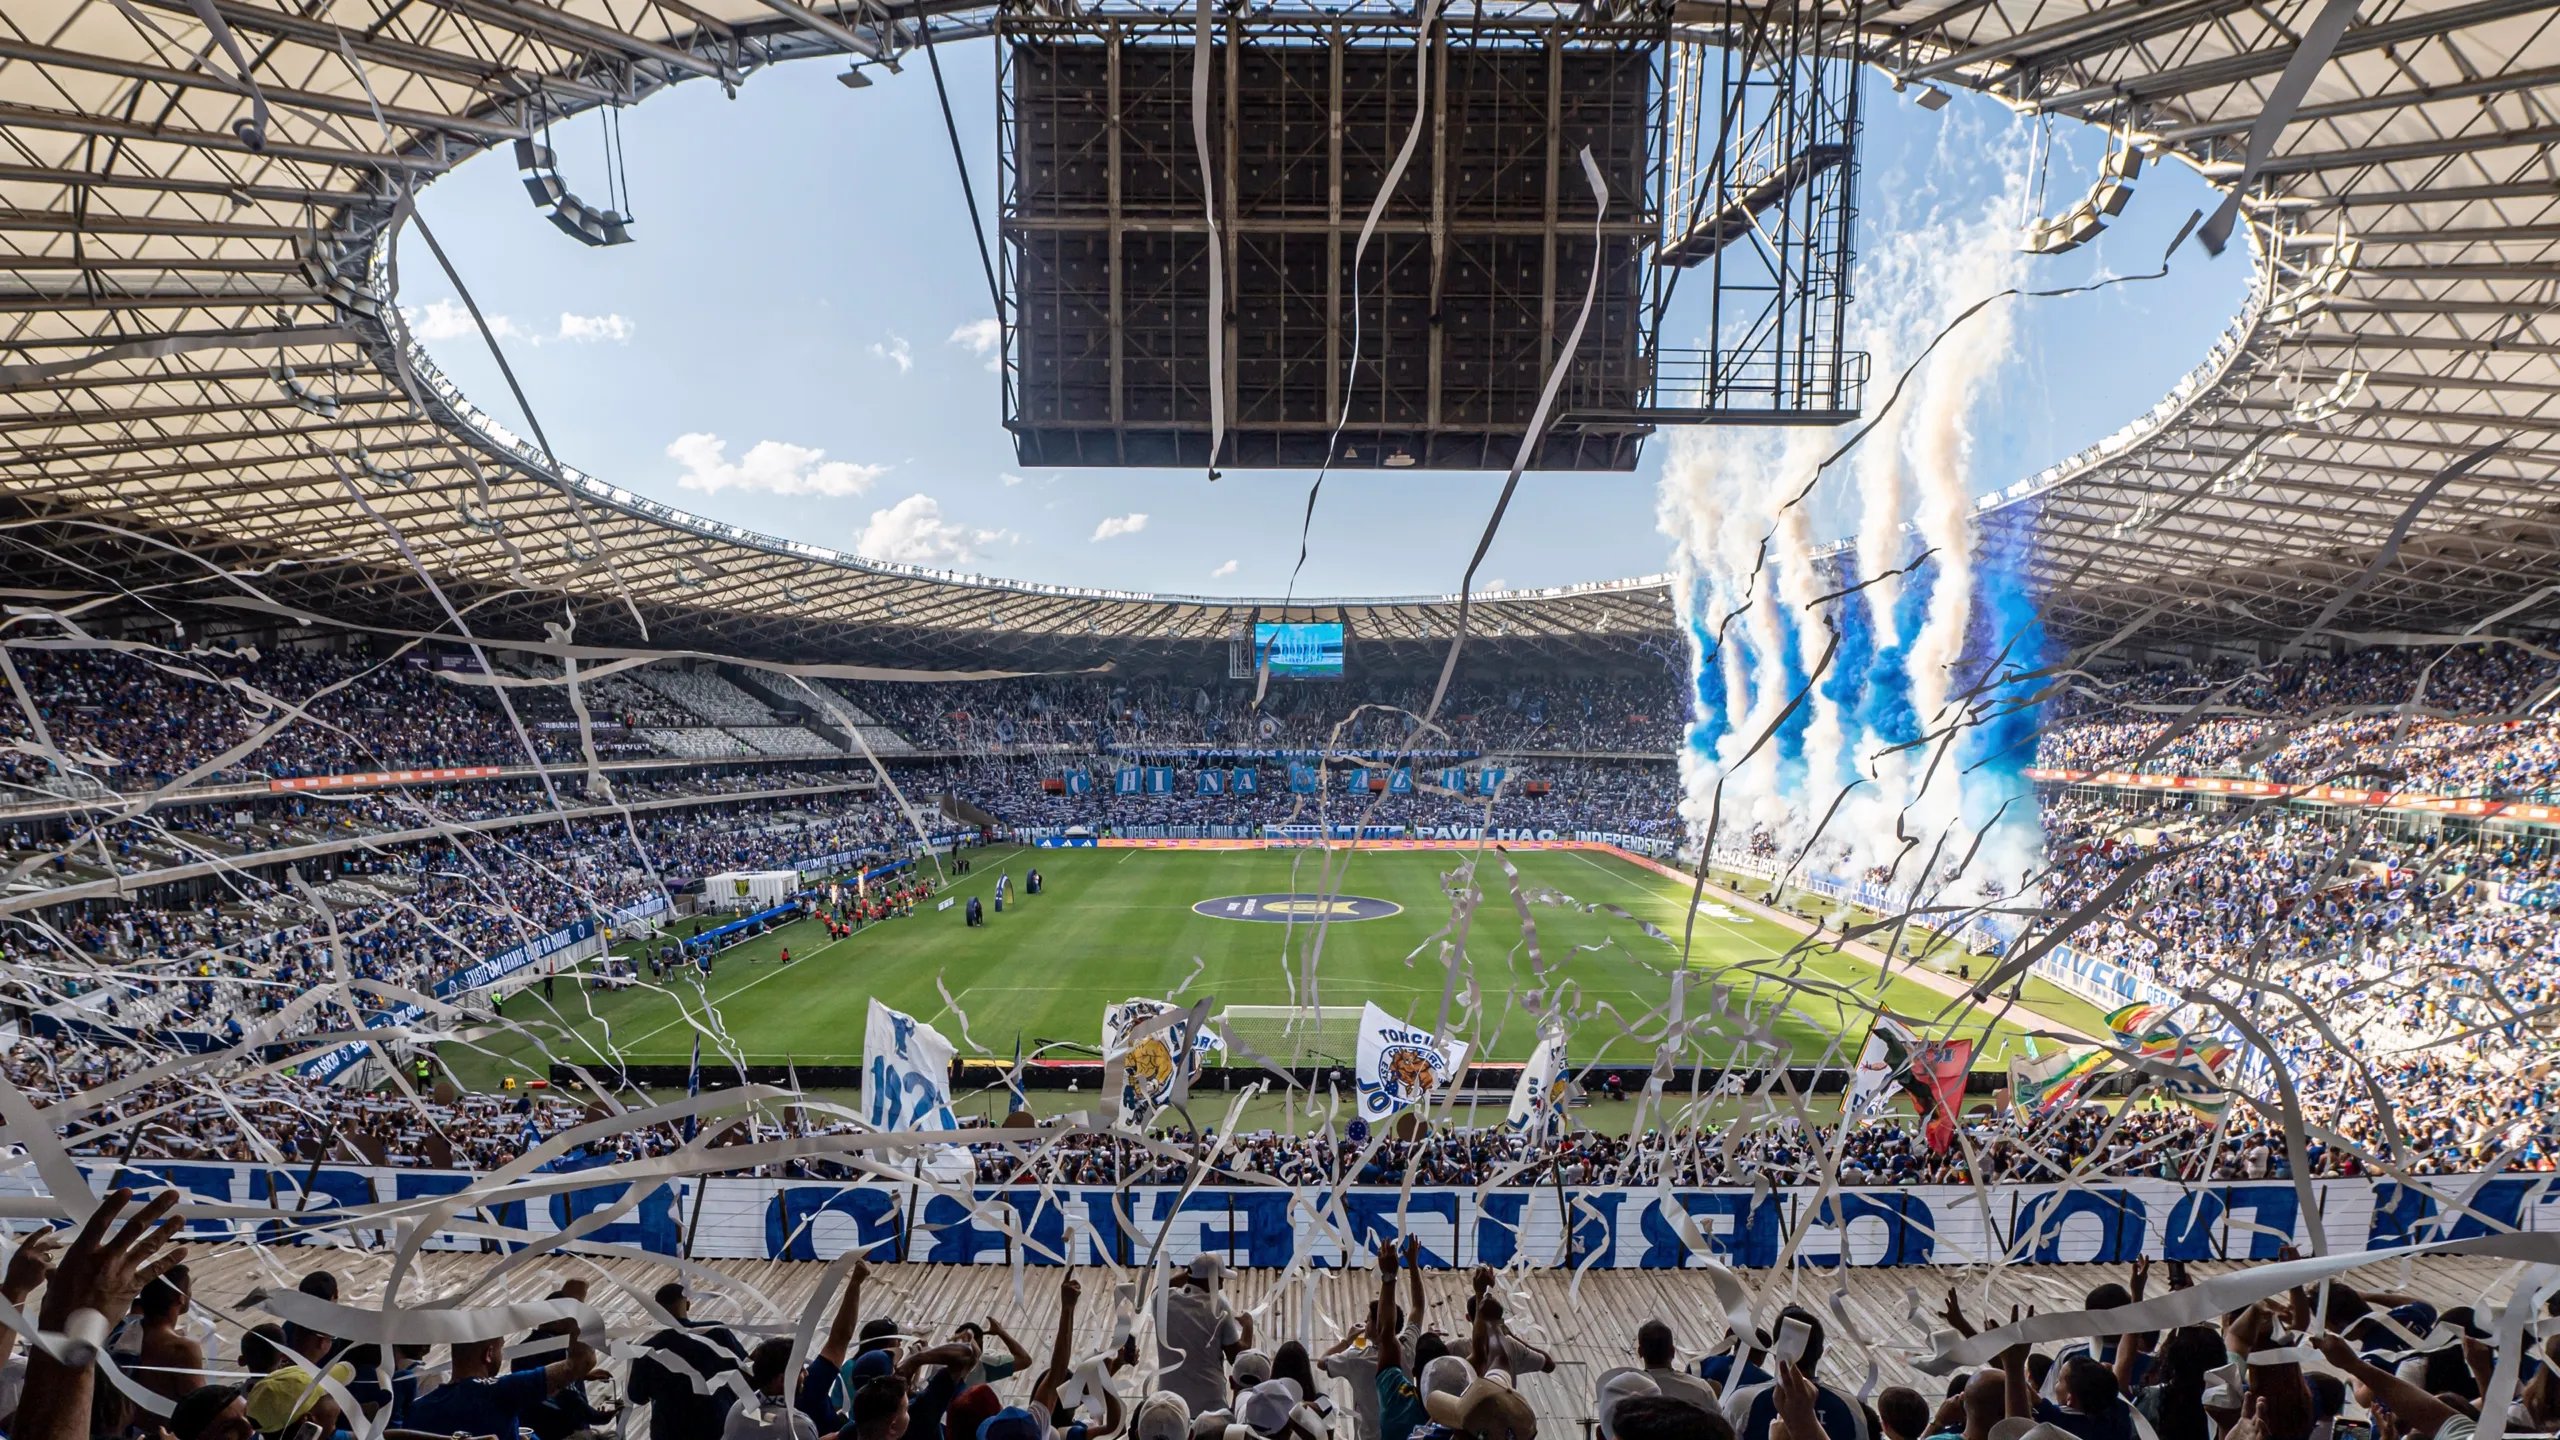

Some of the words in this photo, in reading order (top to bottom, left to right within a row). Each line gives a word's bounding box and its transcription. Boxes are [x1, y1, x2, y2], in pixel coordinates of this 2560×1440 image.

[1070, 770, 1253, 794] CHINA
[1168, 825, 1200, 839] ATITUDE
[1202, 825, 1208, 839] E
[1575, 830, 1675, 858] INDEPENDENTE
[1709, 853, 1786, 874] ACHAZEIROS
[464, 964, 489, 989] EXISTE
[489, 957, 503, 979] UM
[501, 947, 526, 973] GRANDE
[525, 939, 544, 961] CLBE
[543, 936, 553, 953] NA
[2041, 945, 2140, 1001] OVEM
[1379, 1028, 1435, 1046] TORCI
[317, 1051, 340, 1075] SÓCIO
[1388, 1046, 1441, 1070] CRZEIRO
